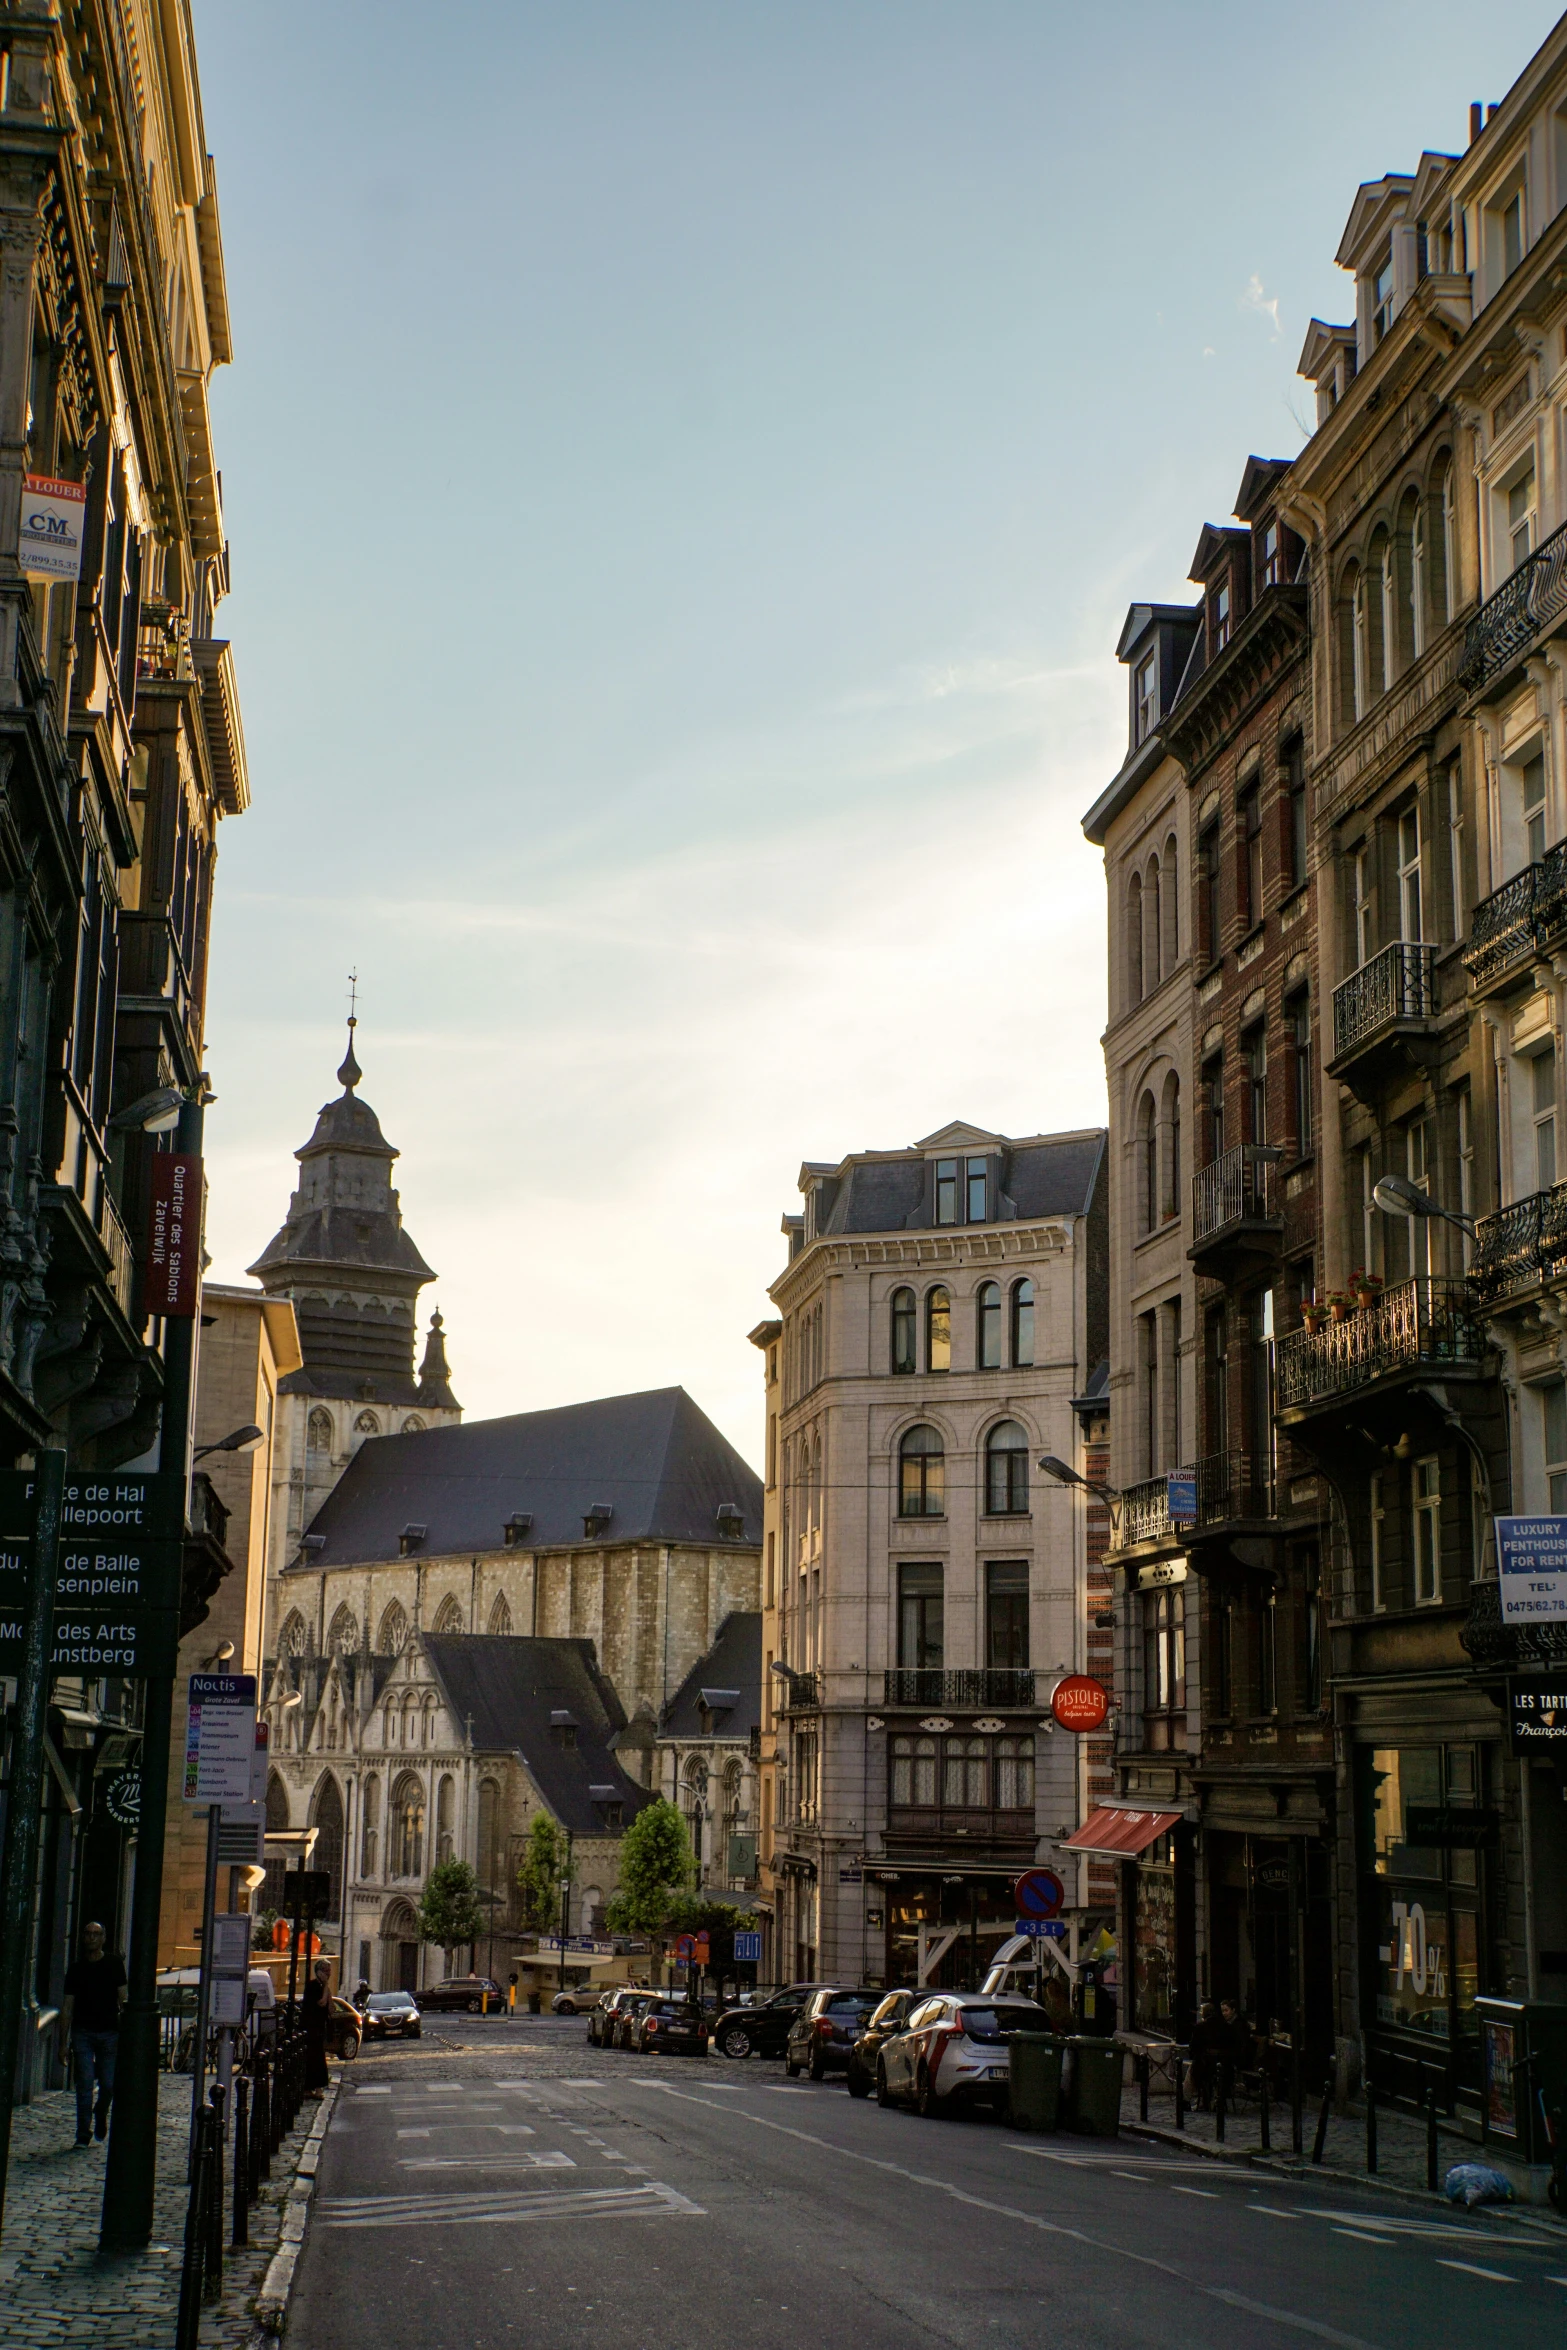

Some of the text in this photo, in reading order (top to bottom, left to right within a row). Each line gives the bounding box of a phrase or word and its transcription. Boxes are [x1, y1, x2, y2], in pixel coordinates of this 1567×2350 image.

[35, 481, 82, 499] LOUER
[29, 514, 69, 536] CM
[21, 530, 77, 548] PROPERTIES
[152, 1200, 168, 1265] Zavelwijk
[167, 1165, 186, 1303] Quartier des Sablons
[85, 1484, 110, 1502] de
[115, 1485, 145, 1502] Hal
[1513, 1523, 1561, 1536] LUXURY
[1503, 1539, 1567, 1552] PENTHOUS
[64, 1553, 89, 1571] de
[95, 1554, 140, 1571] Balle
[1511, 1556, 1535, 1567] FOR
[1528, 1583, 1556, 1592] TEL:
[57, 1623, 136, 1641] des Arts
[49, 1646, 136, 1667] unstberg
[205, 1696, 241, 1704] Grote Zavel
[1057, 1689, 1106, 1709] PISTOLET
[1515, 1695, 1535, 1708] LES
[107, 1772, 143, 1794] MAYER
[106, 1801, 141, 1824] BARBERS
[1378, 1901, 1446, 1998] -70%
[1087, 1972, 1094, 1983] P
